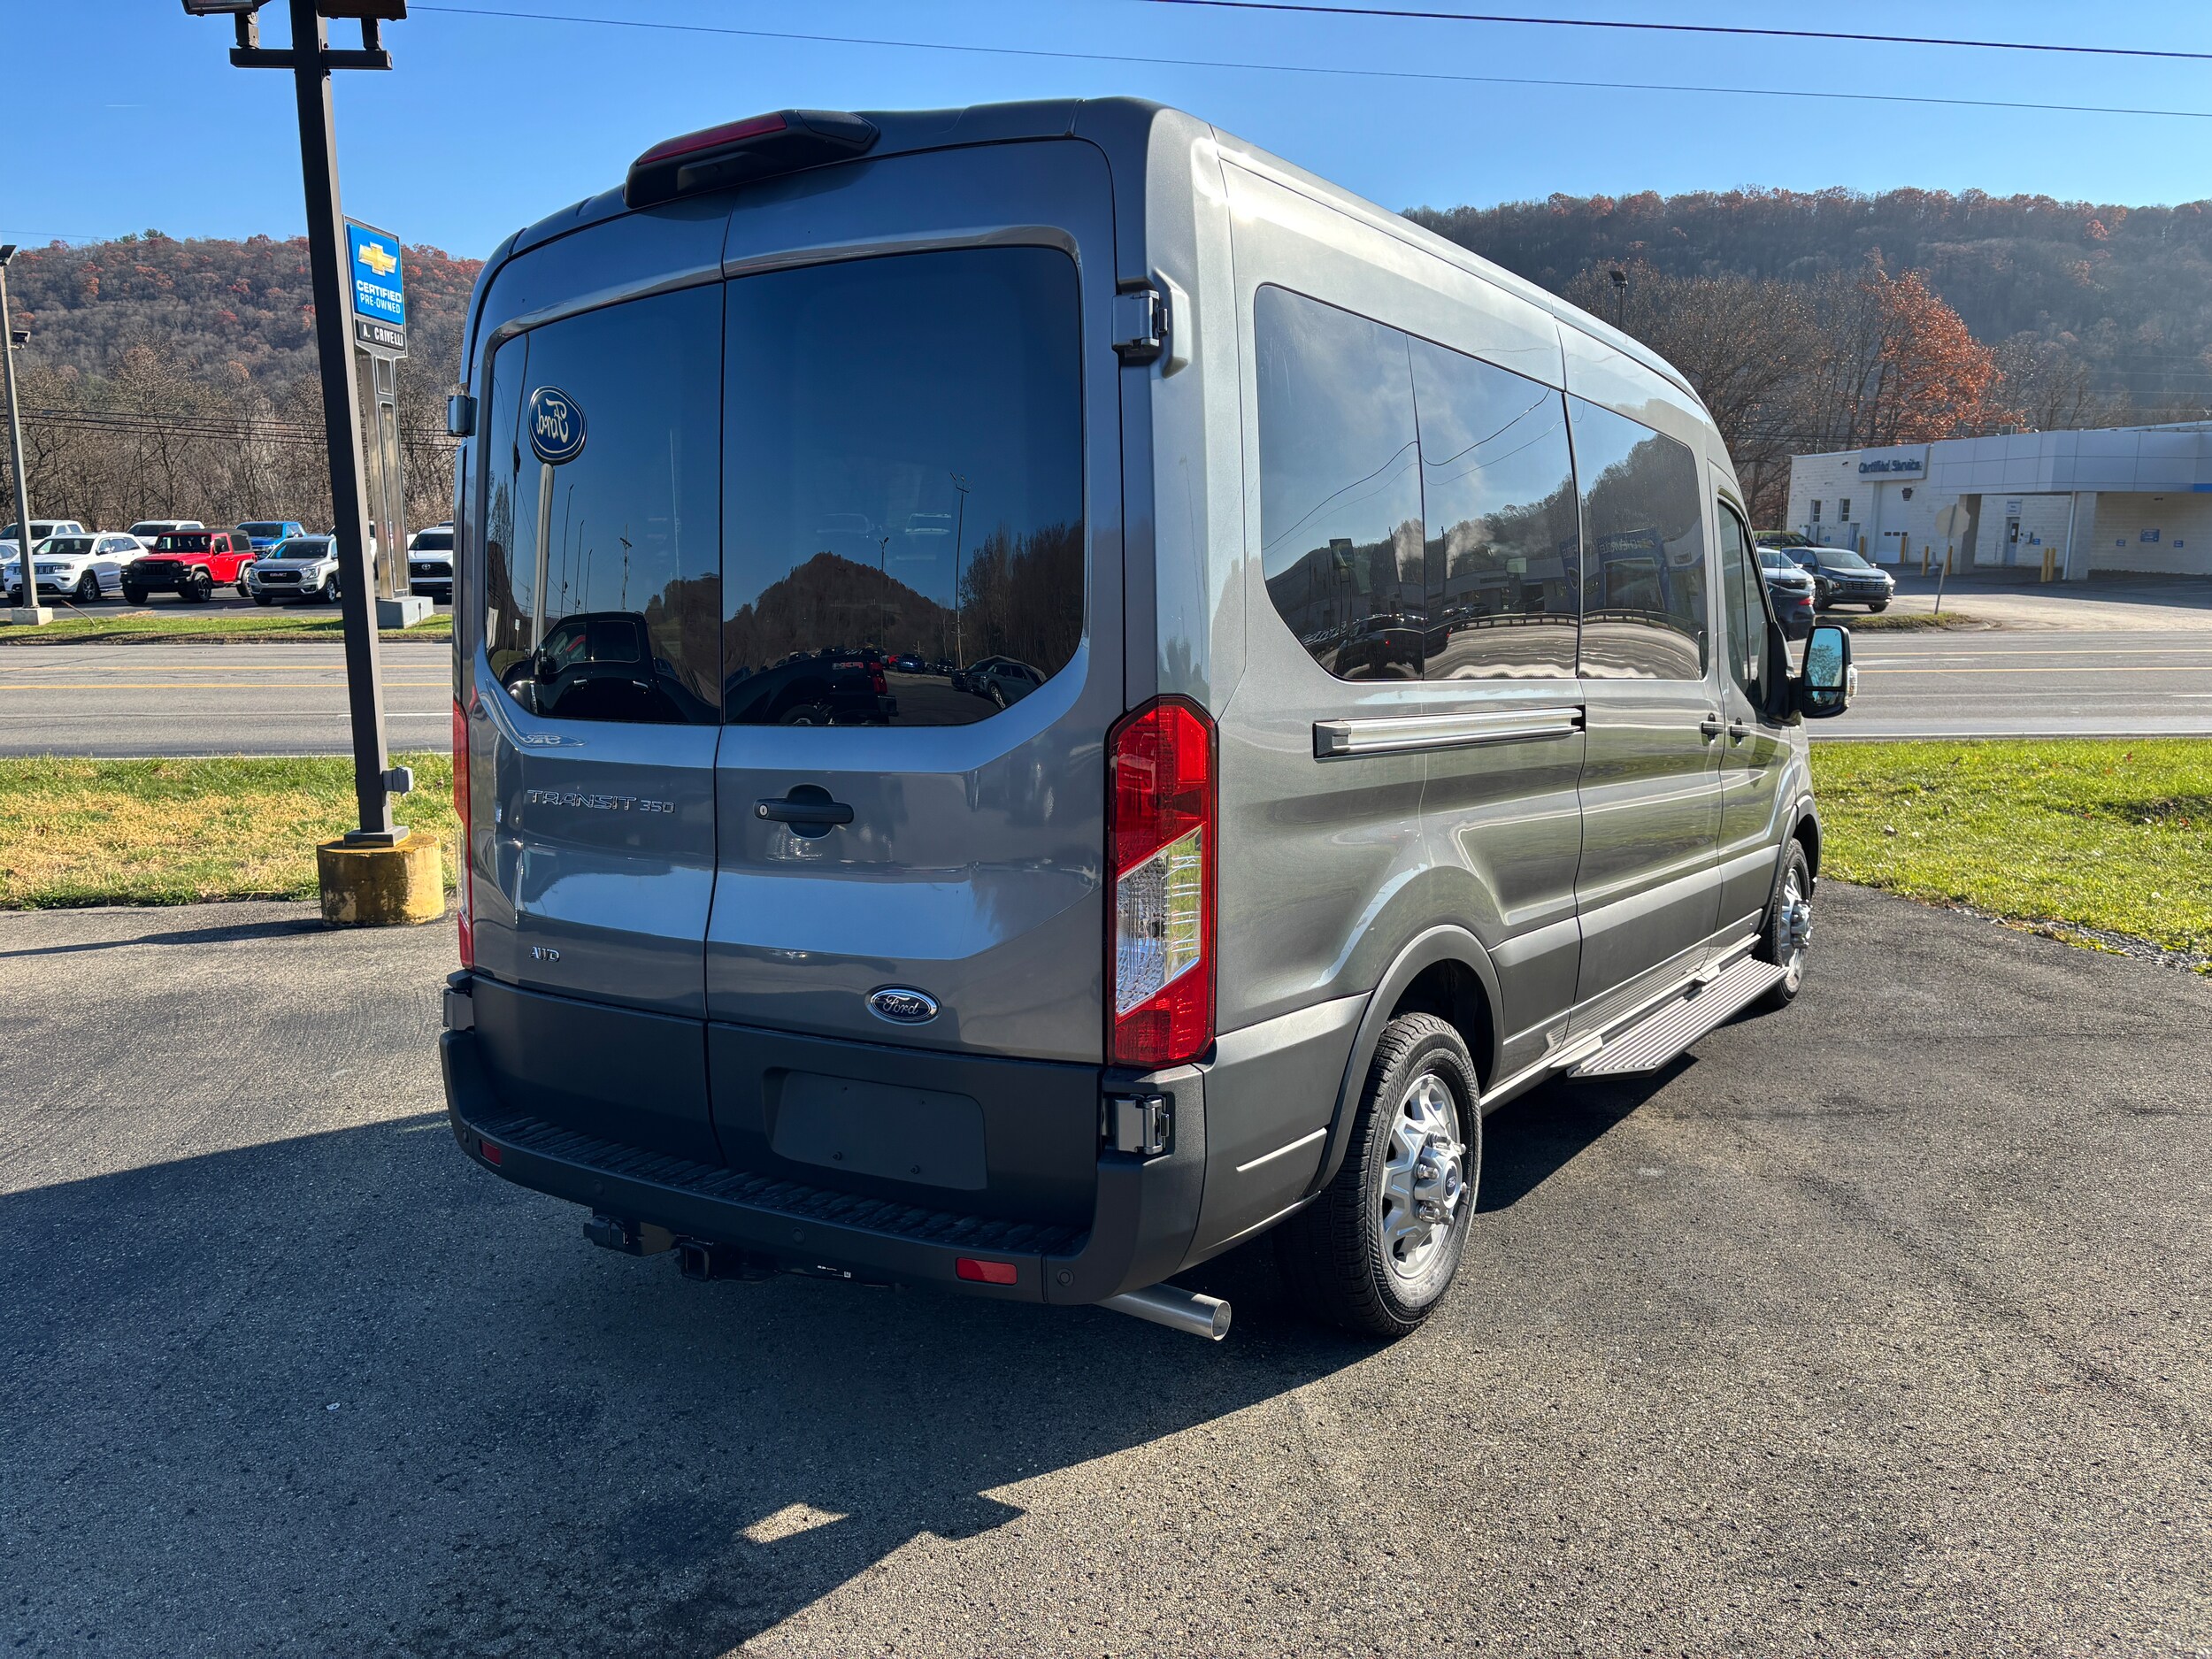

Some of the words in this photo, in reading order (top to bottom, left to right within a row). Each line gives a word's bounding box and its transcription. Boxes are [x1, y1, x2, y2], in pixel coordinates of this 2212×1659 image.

[357, 280, 402, 303] CERTIFIED
[360, 293, 400, 313] PRE-OWNED
[364, 324, 371, 338] A.
[374, 326, 403, 347] CRIVELLI
[527, 789, 637, 810] TRANSIT
[640, 800, 675, 813] 350
[529, 946, 560, 962] AWD
[882, 995, 920, 1015] Ford
